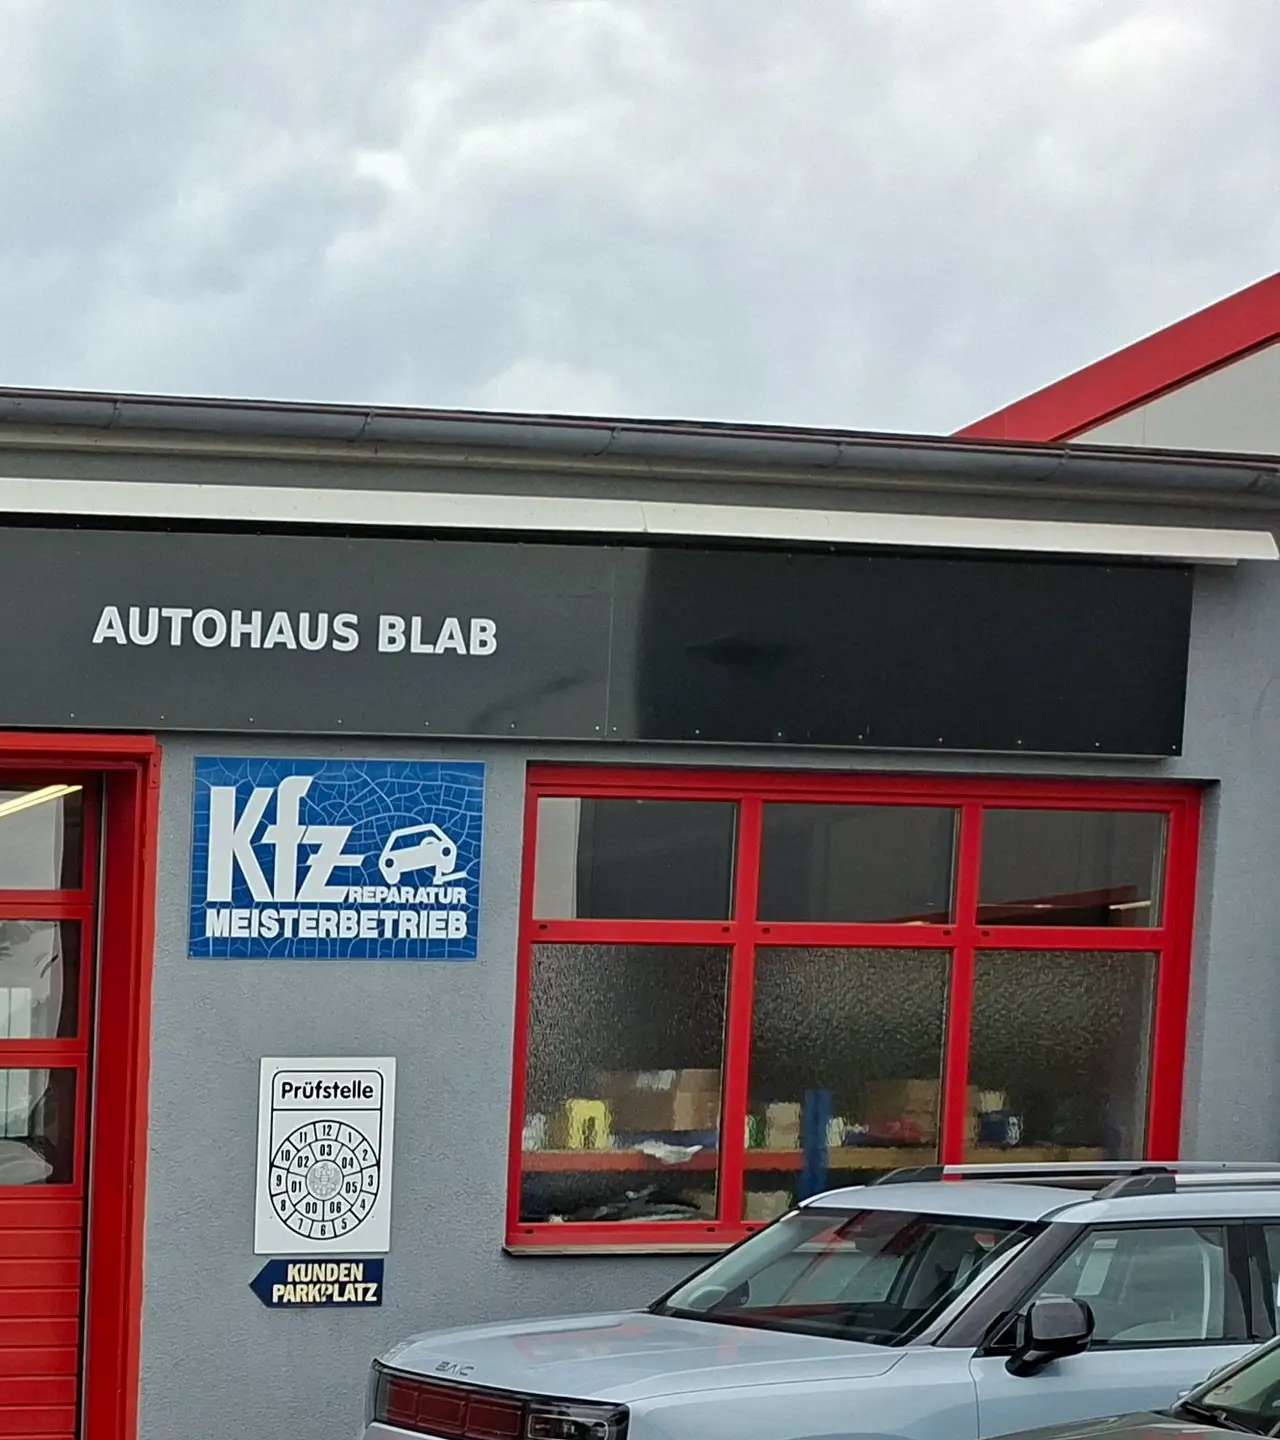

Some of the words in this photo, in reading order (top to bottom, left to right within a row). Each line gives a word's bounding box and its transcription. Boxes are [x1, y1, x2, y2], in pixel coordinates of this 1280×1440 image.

[92, 606, 359, 652] AUTOHAUS
[377, 615, 497, 656] BLAB
[206, 775, 364, 903] Kfz
[348, 886, 467, 905] REPARATUR
[205, 908, 468, 940] MEISTERBETRIEB
[281, 1080, 374, 1100] Prüfstelle
[322, 1124, 332, 1136] 12
[299, 1131, 307, 1143] 11
[348, 1132, 352, 1143] 1
[281, 1150, 290, 1162] 10
[320, 1144, 332, 1156] 03
[363, 1150, 368, 1161] 2
[297, 1156, 309, 1168] 02
[342, 1157, 354, 1169] 04
[276, 1175, 282, 1187] 9
[368, 1174, 374, 1187] 3
[291, 1181, 302, 1193] 01
[345, 1181, 357, 1194] 05
[280, 1200, 286, 1211] 8
[305, 1202, 317, 1214] 00
[329, 1201, 341, 1213] 06
[360, 1198, 366, 1210] 4
[298, 1219, 303, 1230] 7
[341, 1218, 347, 1230] 5
[320, 1225, 326, 1236] 6
[287, 1263, 364, 1282] KUNDEN
[272, 1282, 378, 1303] PARKPLATZ
